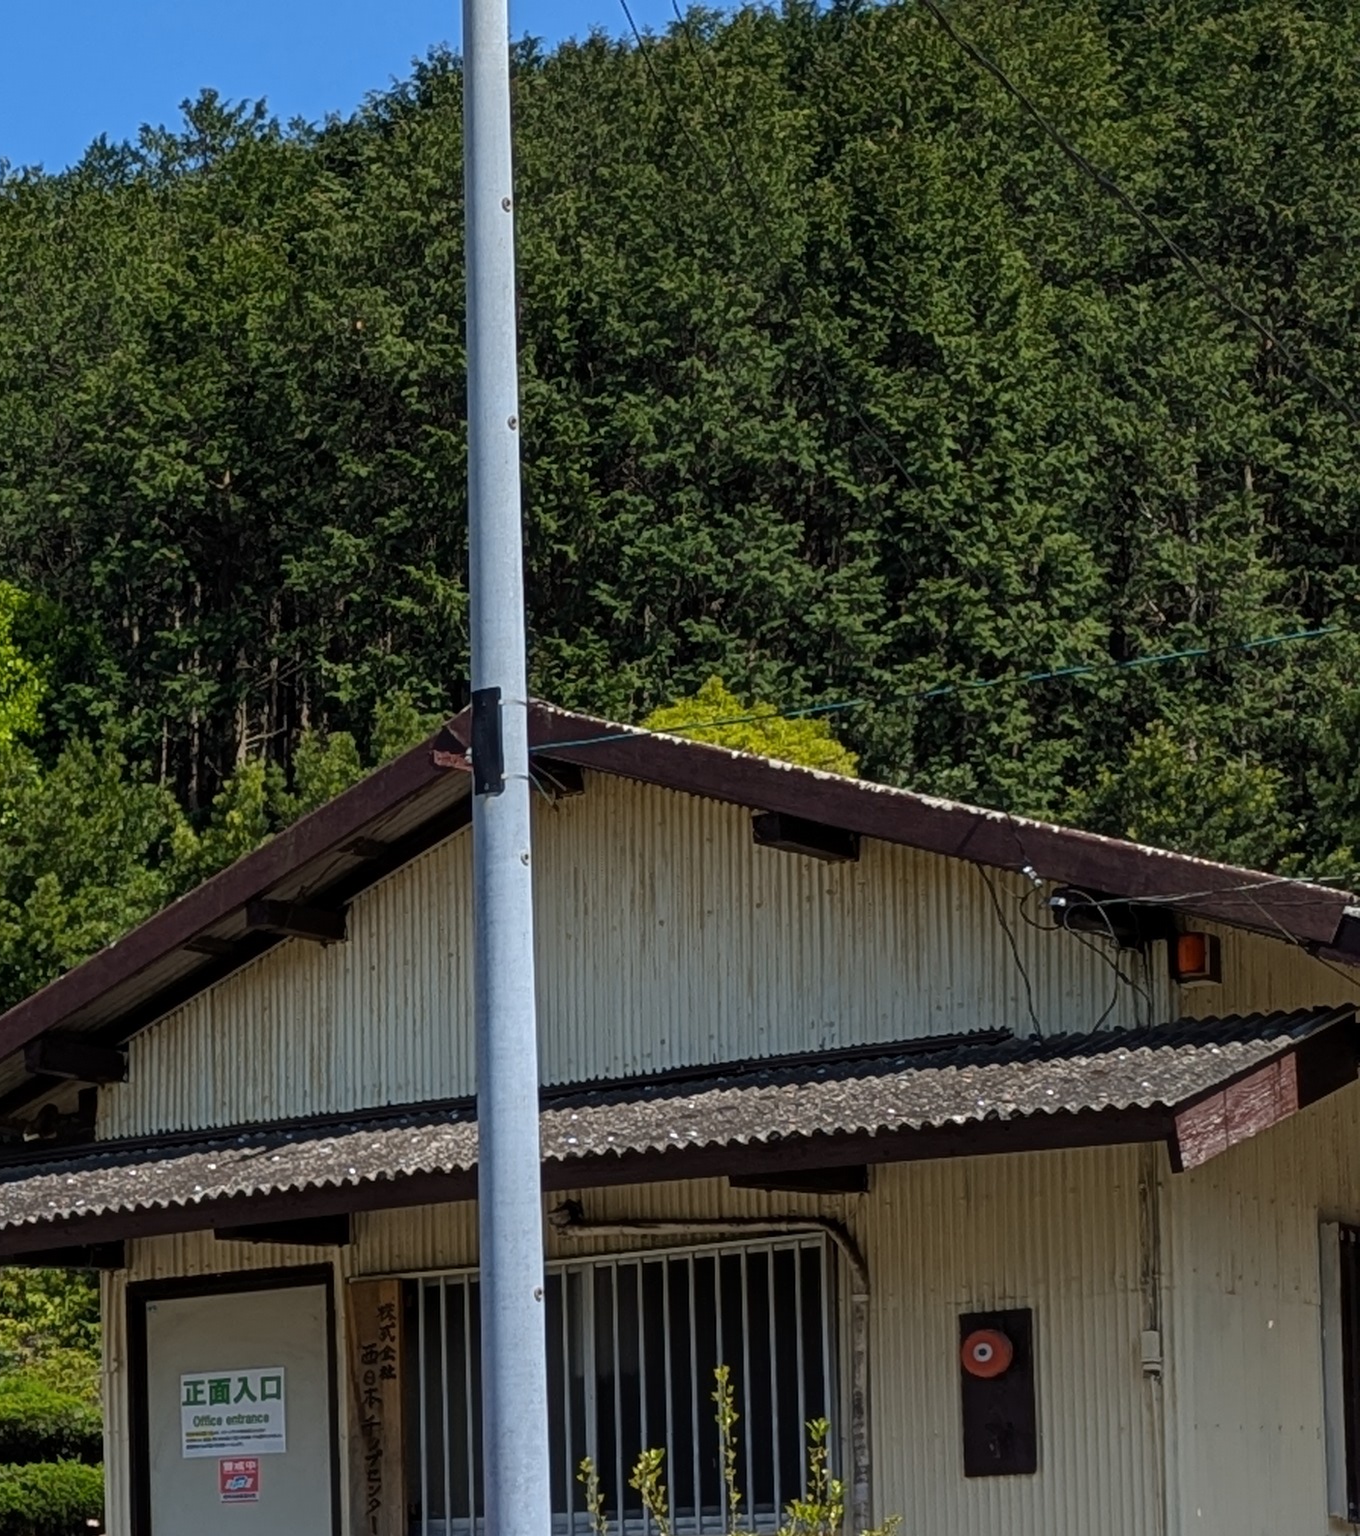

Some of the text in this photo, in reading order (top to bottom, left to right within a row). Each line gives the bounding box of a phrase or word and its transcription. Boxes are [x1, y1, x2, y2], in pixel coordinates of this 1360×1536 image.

[376, 1302, 397, 1380] 株式会社
[182, 1376, 282, 1406] 正面入口
[192, 1413, 270, 1428] Office entrance
[361, 1343, 383, 1536] 西日本チップセンター
